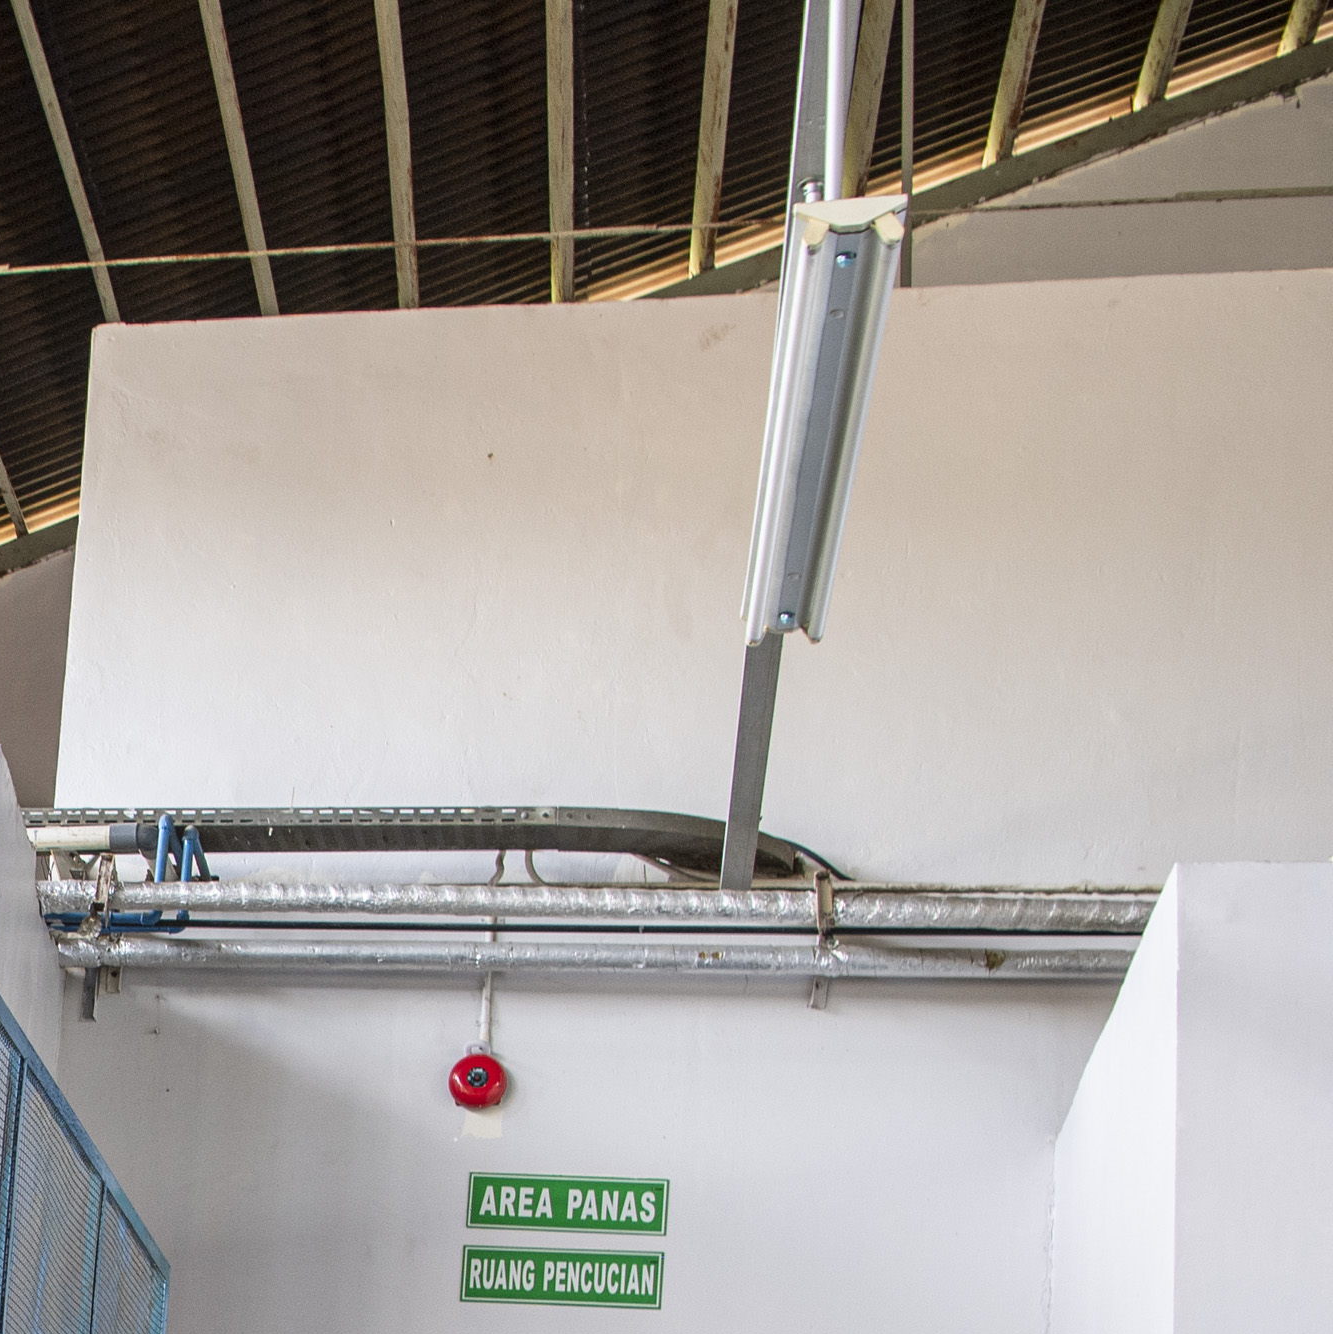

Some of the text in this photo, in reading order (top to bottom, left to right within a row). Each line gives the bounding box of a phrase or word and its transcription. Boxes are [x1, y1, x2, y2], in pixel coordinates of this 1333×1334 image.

[479, 1185, 656, 1223] AREA PANAS
[469, 1257, 655, 1296] RUANG PENCUCIAN
